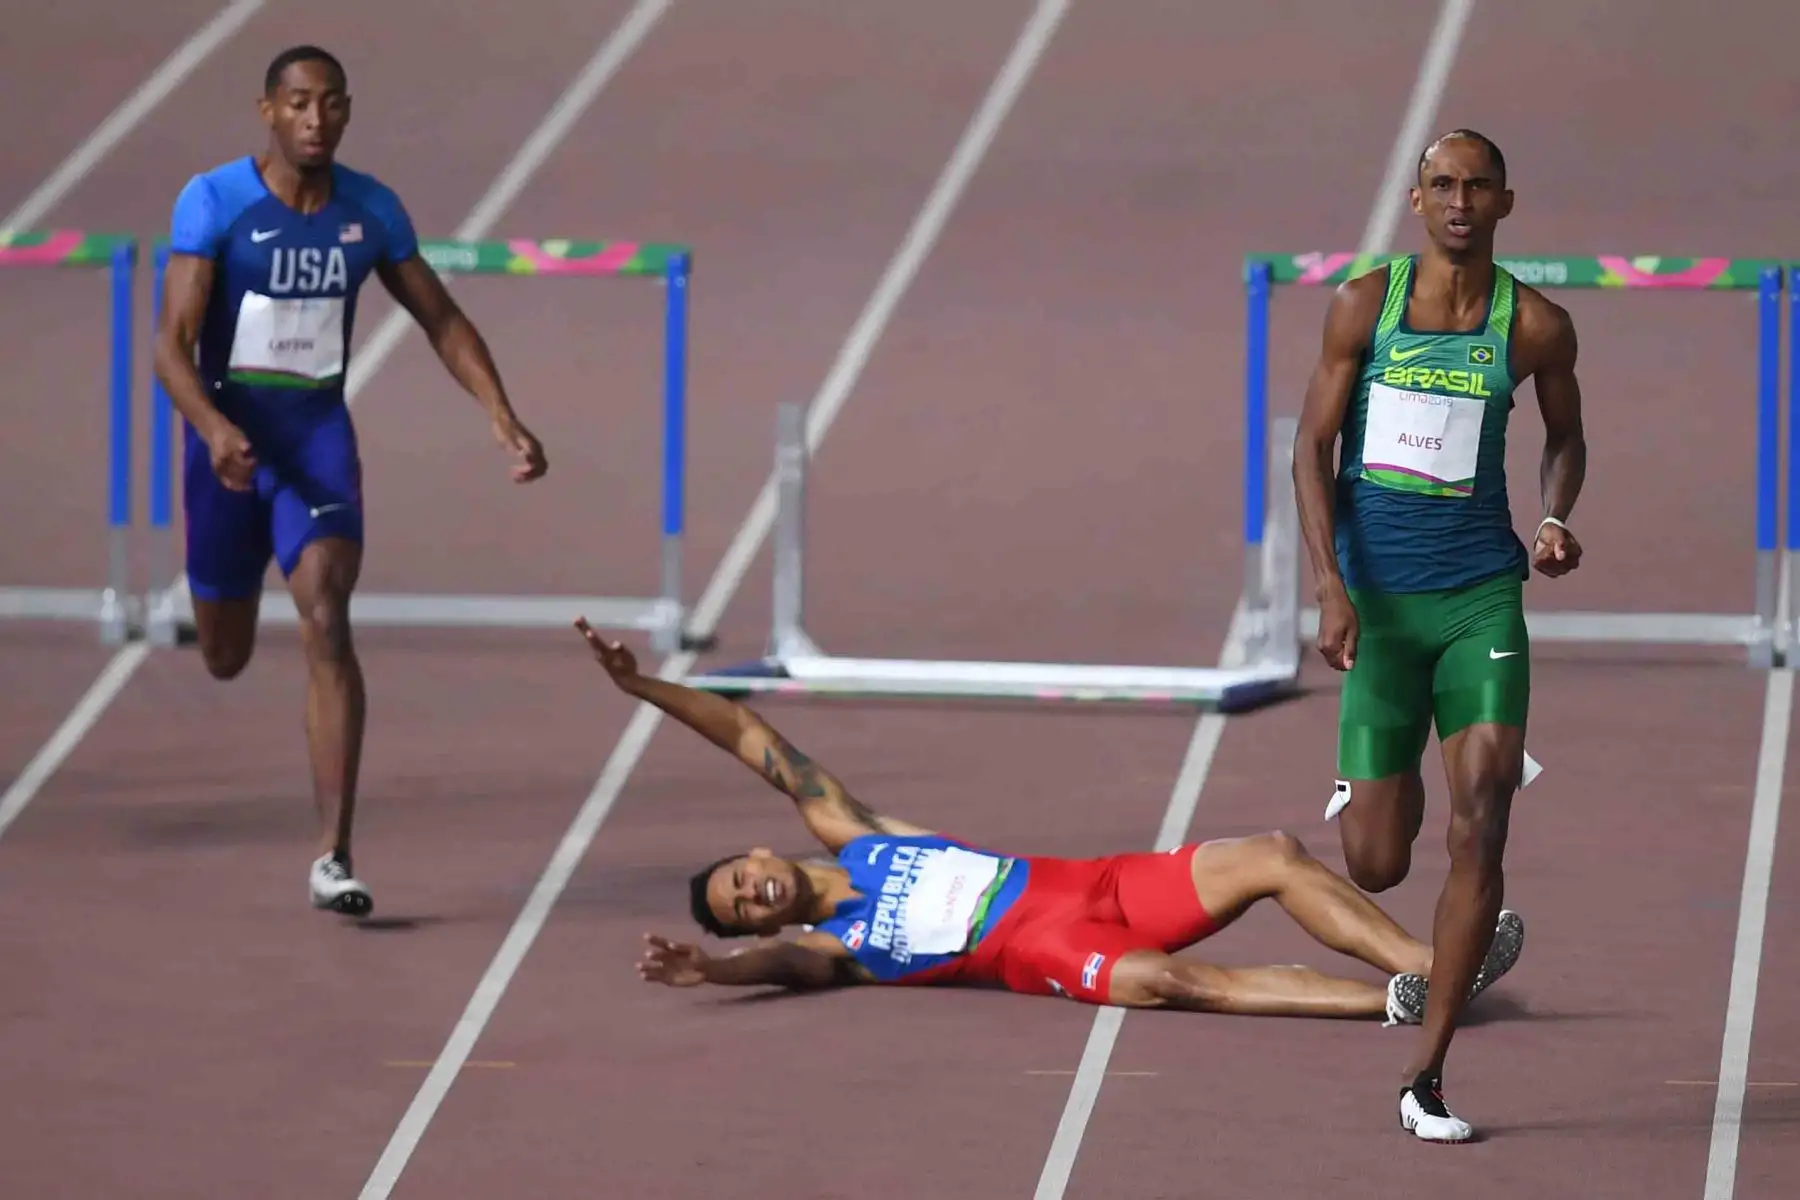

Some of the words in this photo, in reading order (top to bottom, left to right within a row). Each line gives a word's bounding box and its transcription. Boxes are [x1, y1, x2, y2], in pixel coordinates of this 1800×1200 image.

[270, 247, 347, 291] USA
[1384, 367, 1491, 396] BRASIL
[1397, 432, 1443, 451] ALVES
[868, 846, 921, 950] REPUBLICA
